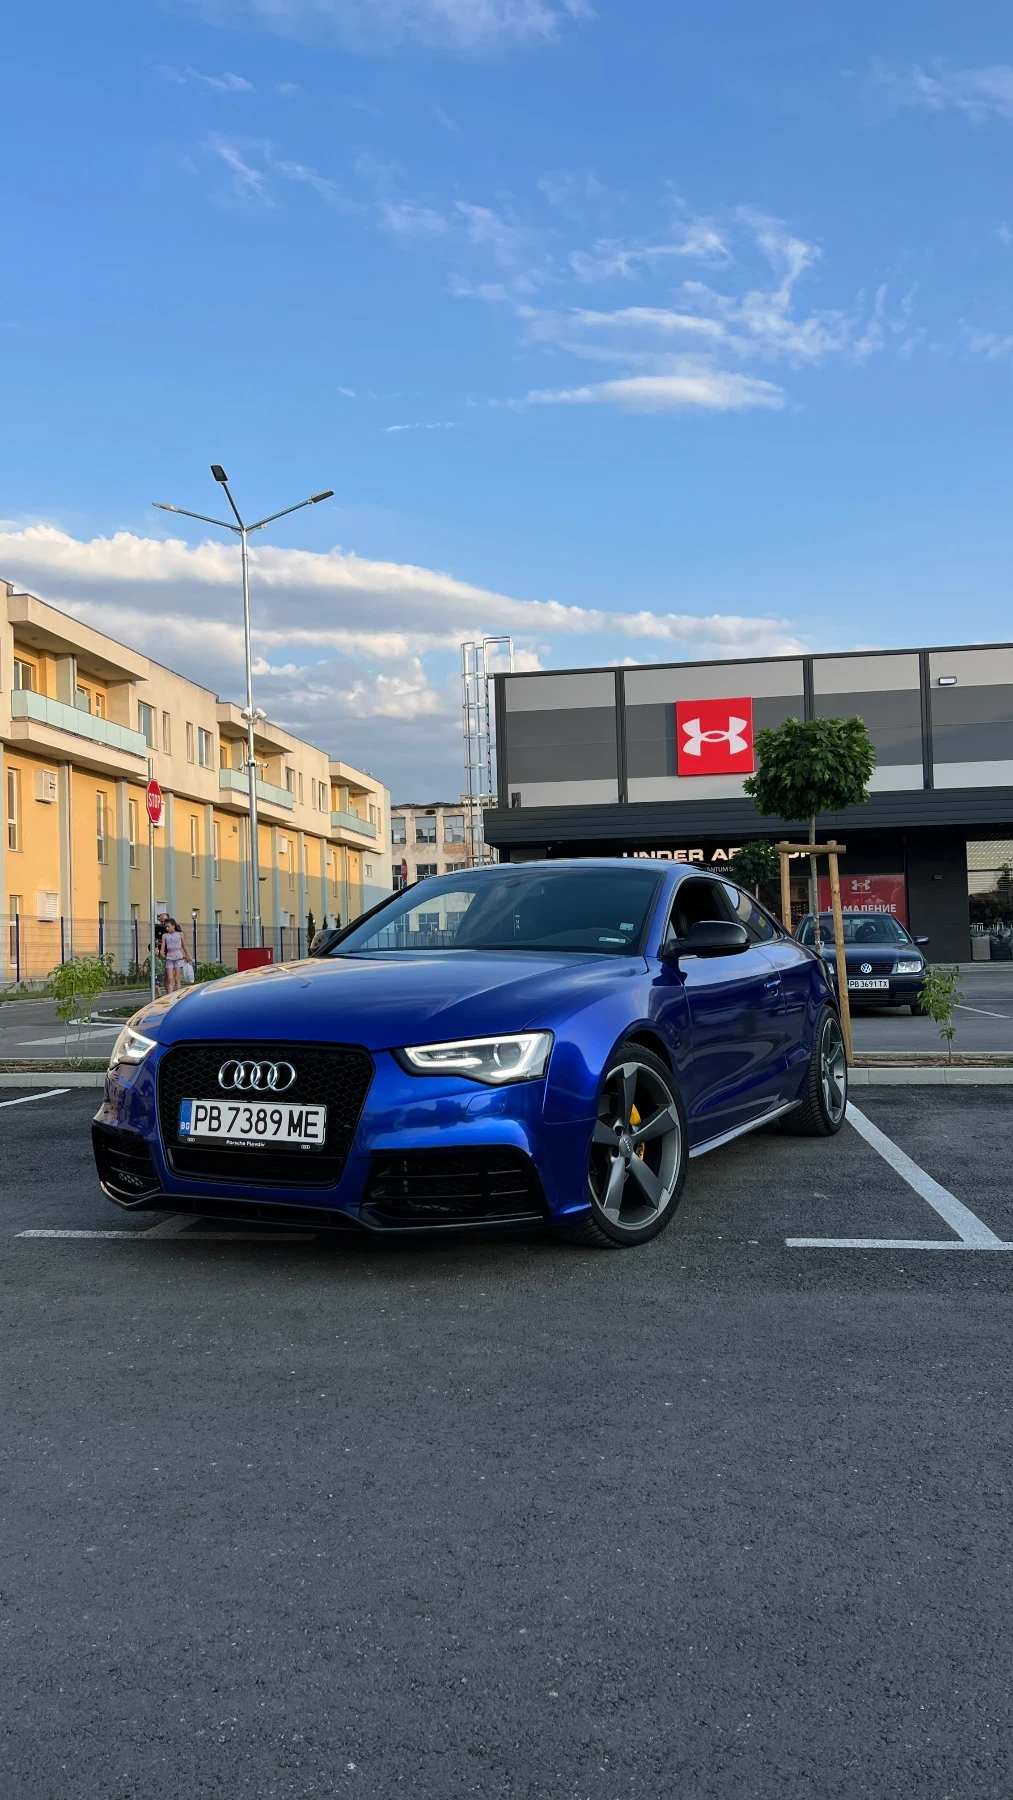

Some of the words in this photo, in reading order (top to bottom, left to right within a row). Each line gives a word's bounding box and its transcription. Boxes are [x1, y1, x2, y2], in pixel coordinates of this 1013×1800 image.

[149, 793, 160, 808] STOP
[827, 904, 897, 913] НМАЛЕНИЕ
[180, 1121, 191, 1130] BG
[194, 1104, 222, 1132] PB
[226, 1106, 283, 1136] 7389
[287, 1109, 320, 1138] ME
